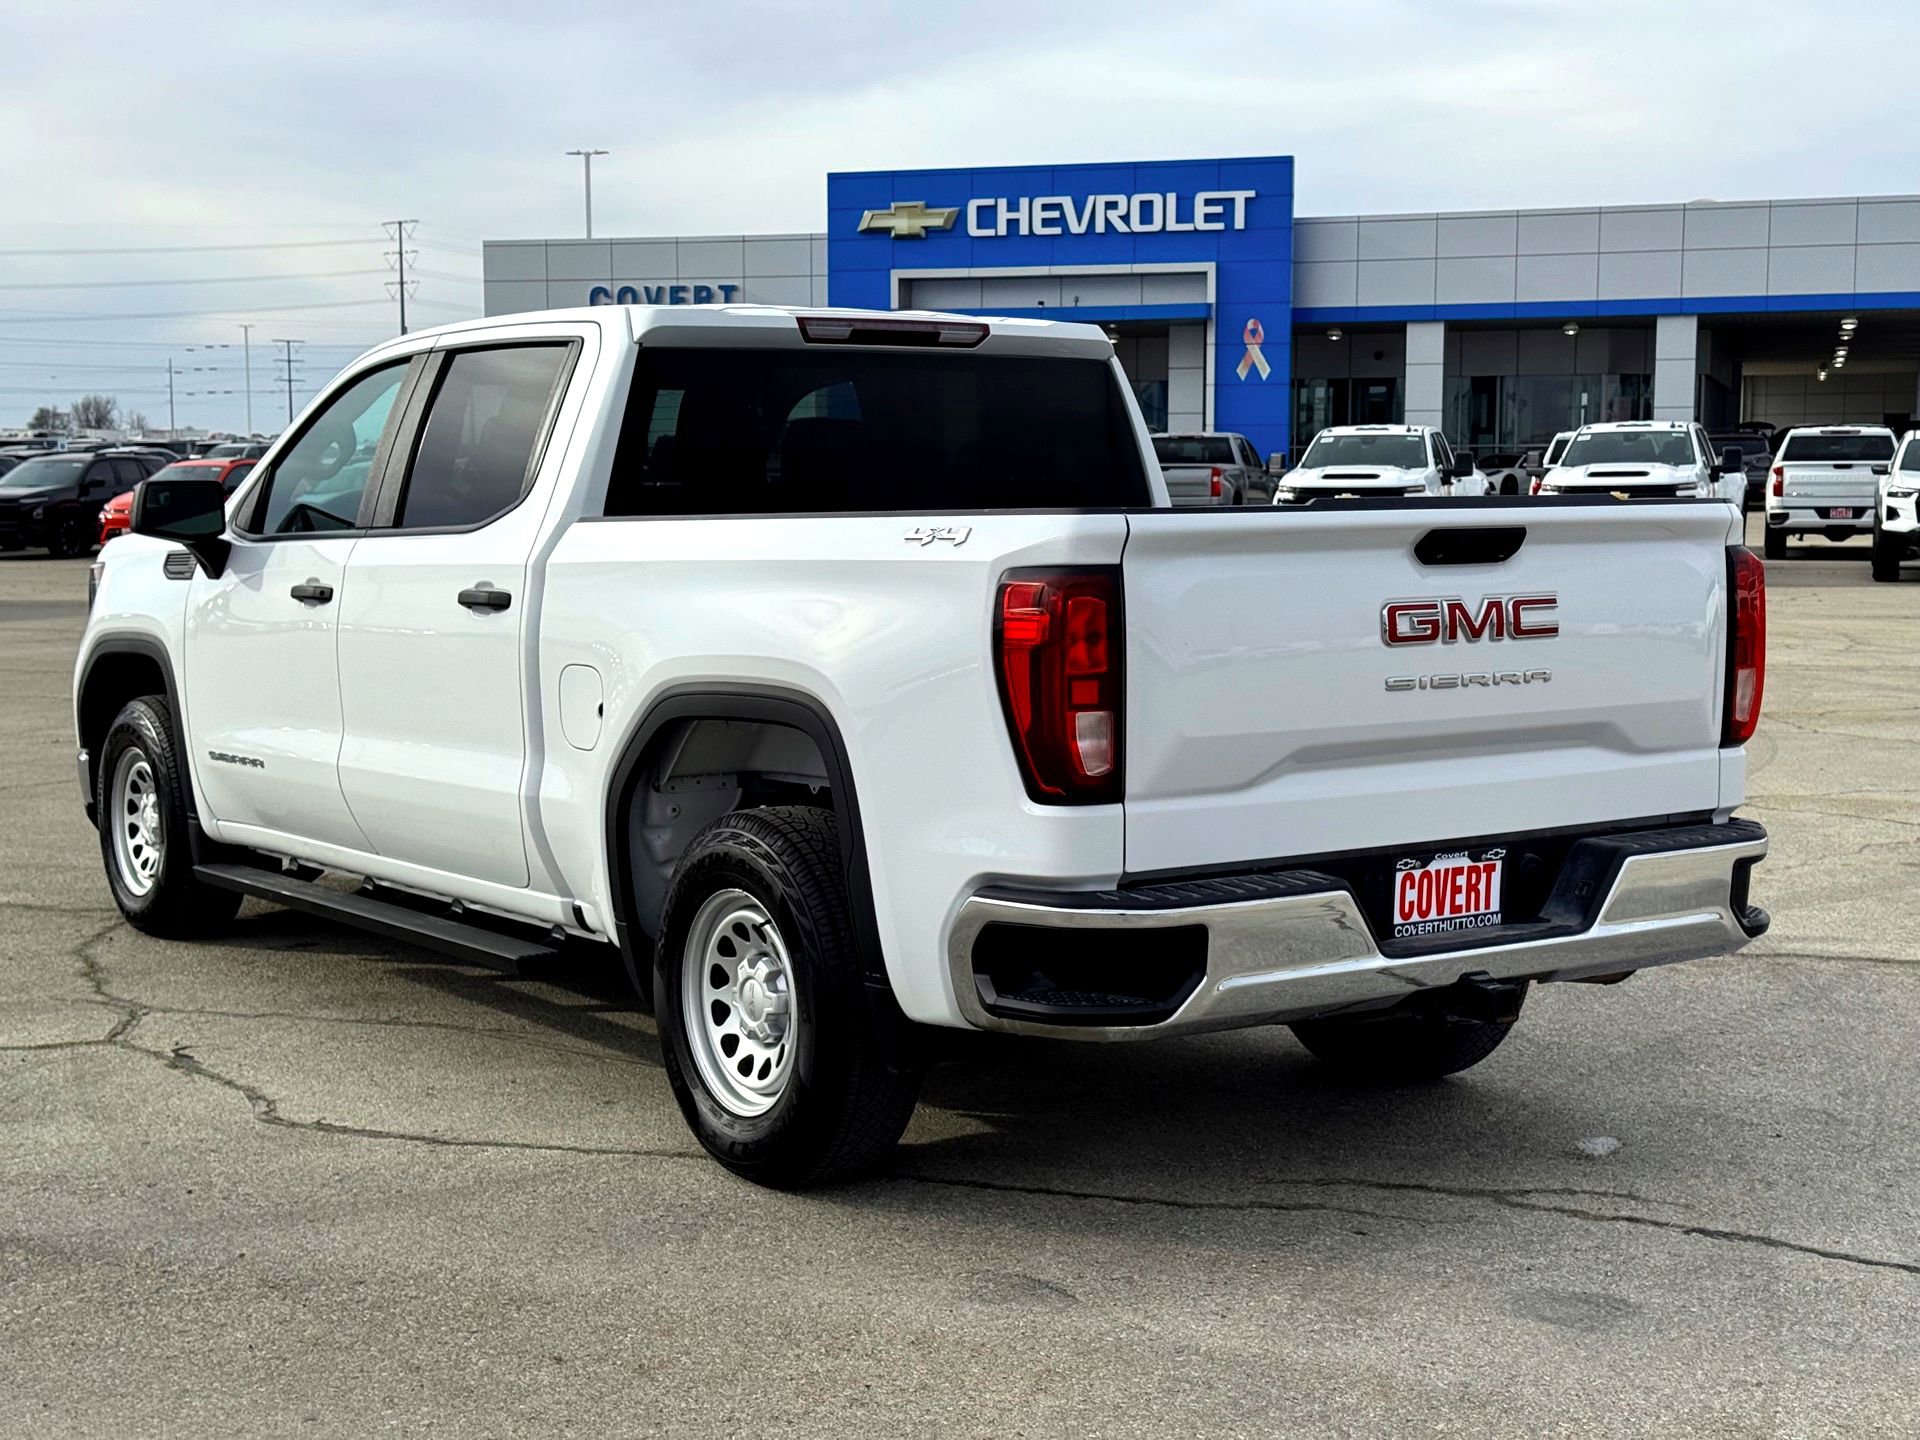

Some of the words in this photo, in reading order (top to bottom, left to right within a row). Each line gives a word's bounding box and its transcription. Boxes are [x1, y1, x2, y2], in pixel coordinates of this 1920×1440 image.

[967, 190, 1256, 237] CHEVROLET
[589, 284, 737, 306] COVERT
[1381, 592, 1559, 647] GMC
[1385, 668, 1552, 691] SIERRA
[1434, 851, 1469, 860] Covert
[1399, 863, 1496, 922] COVERT
[1394, 913, 1502, 938] COVERTHUTTO.COM
